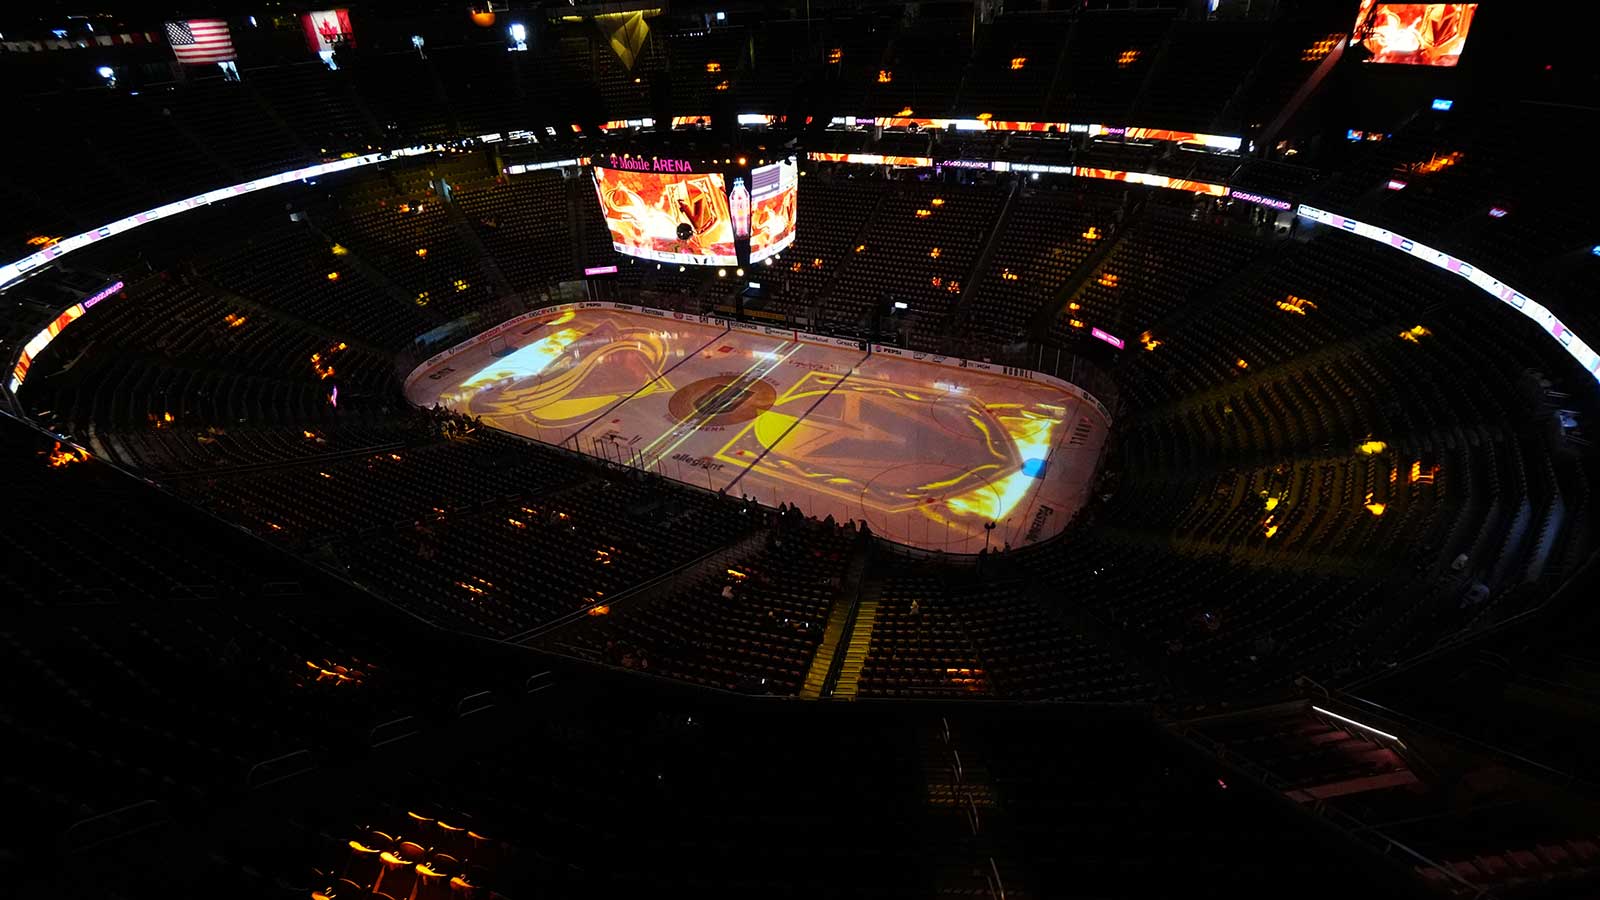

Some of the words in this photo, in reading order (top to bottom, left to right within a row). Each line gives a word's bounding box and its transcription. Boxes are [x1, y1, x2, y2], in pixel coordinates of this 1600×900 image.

[618, 156, 651, 171] Mobile
[653, 159, 693, 173] ARENA
[1231, 191, 1261, 203] COLORADO
[883, 348, 903, 356] PEPSI
[671, 452, 726, 472] allegiant
